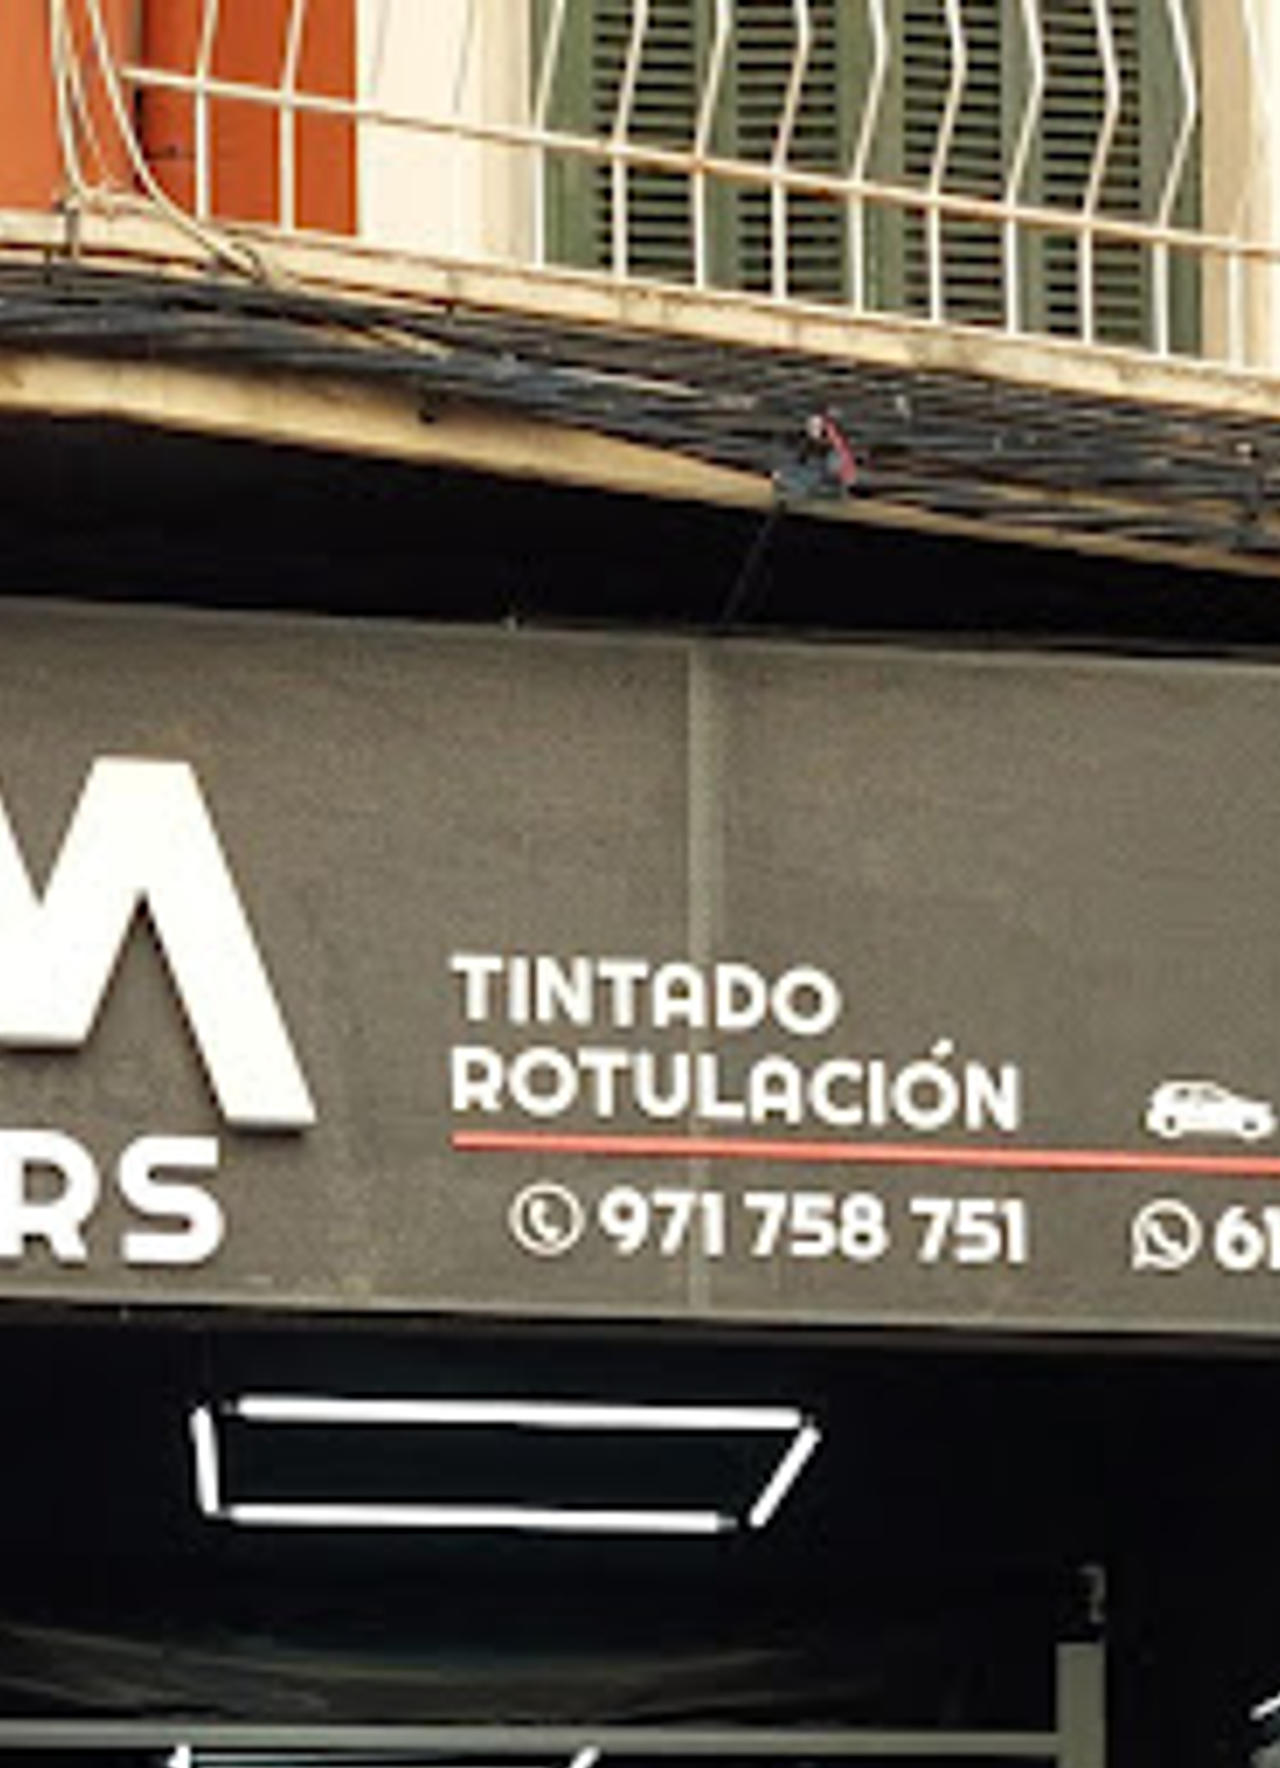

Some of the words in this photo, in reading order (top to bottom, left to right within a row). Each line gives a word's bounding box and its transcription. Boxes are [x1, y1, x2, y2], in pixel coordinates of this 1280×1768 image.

[449, 953, 842, 1036] TINTADO
[450, 1037, 1019, 1132] ROTULACIÓN
[598, 1185, 723, 1256] 971
[743, 1190, 889, 1260] 758
[909, 1197, 1029, 1264] 751
